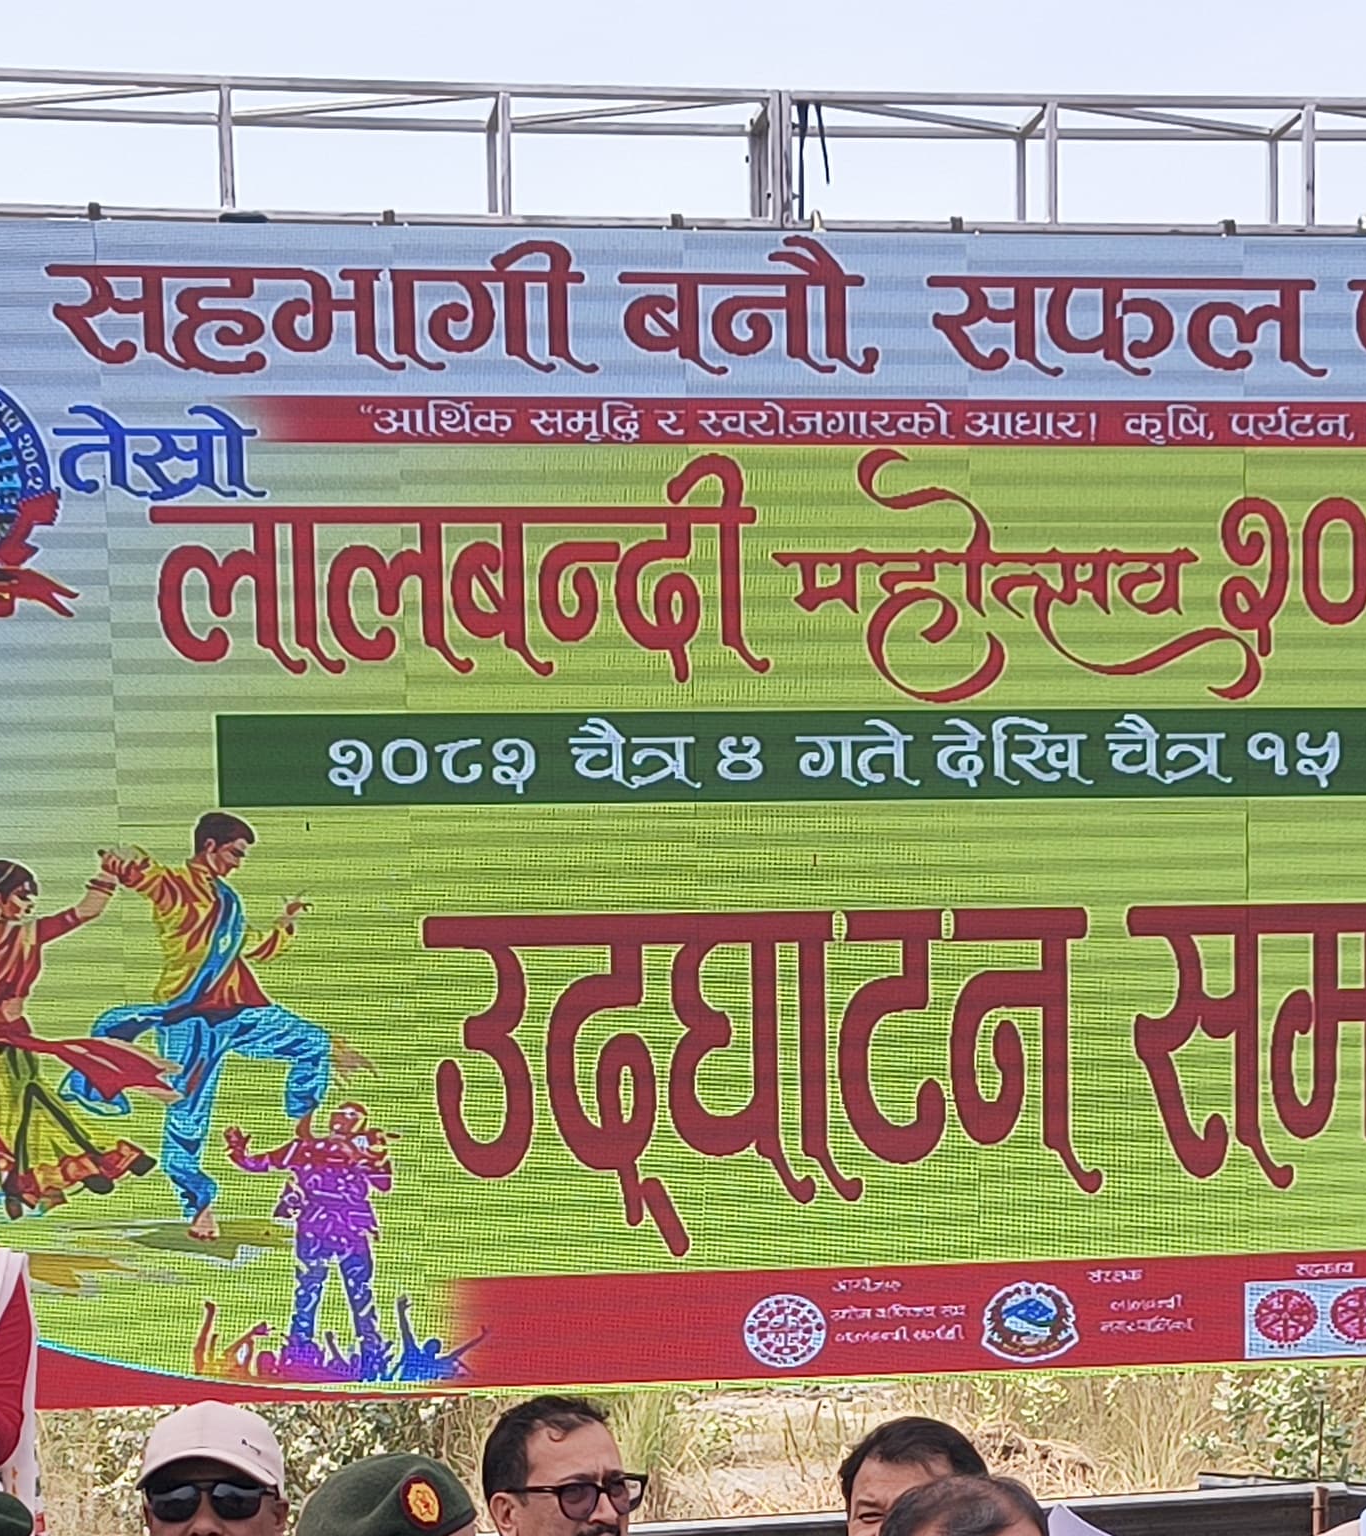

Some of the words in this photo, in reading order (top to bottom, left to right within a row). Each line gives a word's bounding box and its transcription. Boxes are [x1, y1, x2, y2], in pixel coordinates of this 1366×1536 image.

[45, 240, 599, 375] सहभागी
[927, 275, 1328, 377] सफल
[52, 405, 267, 501] तेस्रो
[653, 410, 687, 436] र
[698, 403, 956, 437] स्वरोजगारको
[149, 452, 771, 682] लालबन्दी
[771, 448, 1265, 702] महोत्सव
[327, 737, 536, 795] २०८२
[569, 717, 702, 789] चैत्र
[716, 736, 763, 782] ४
[795, 719, 920, 788] गते
[932, 716, 1094, 788] देखि
[1105, 714, 1233, 784] चैत्र
[1247, 730, 1340, 788] १५
